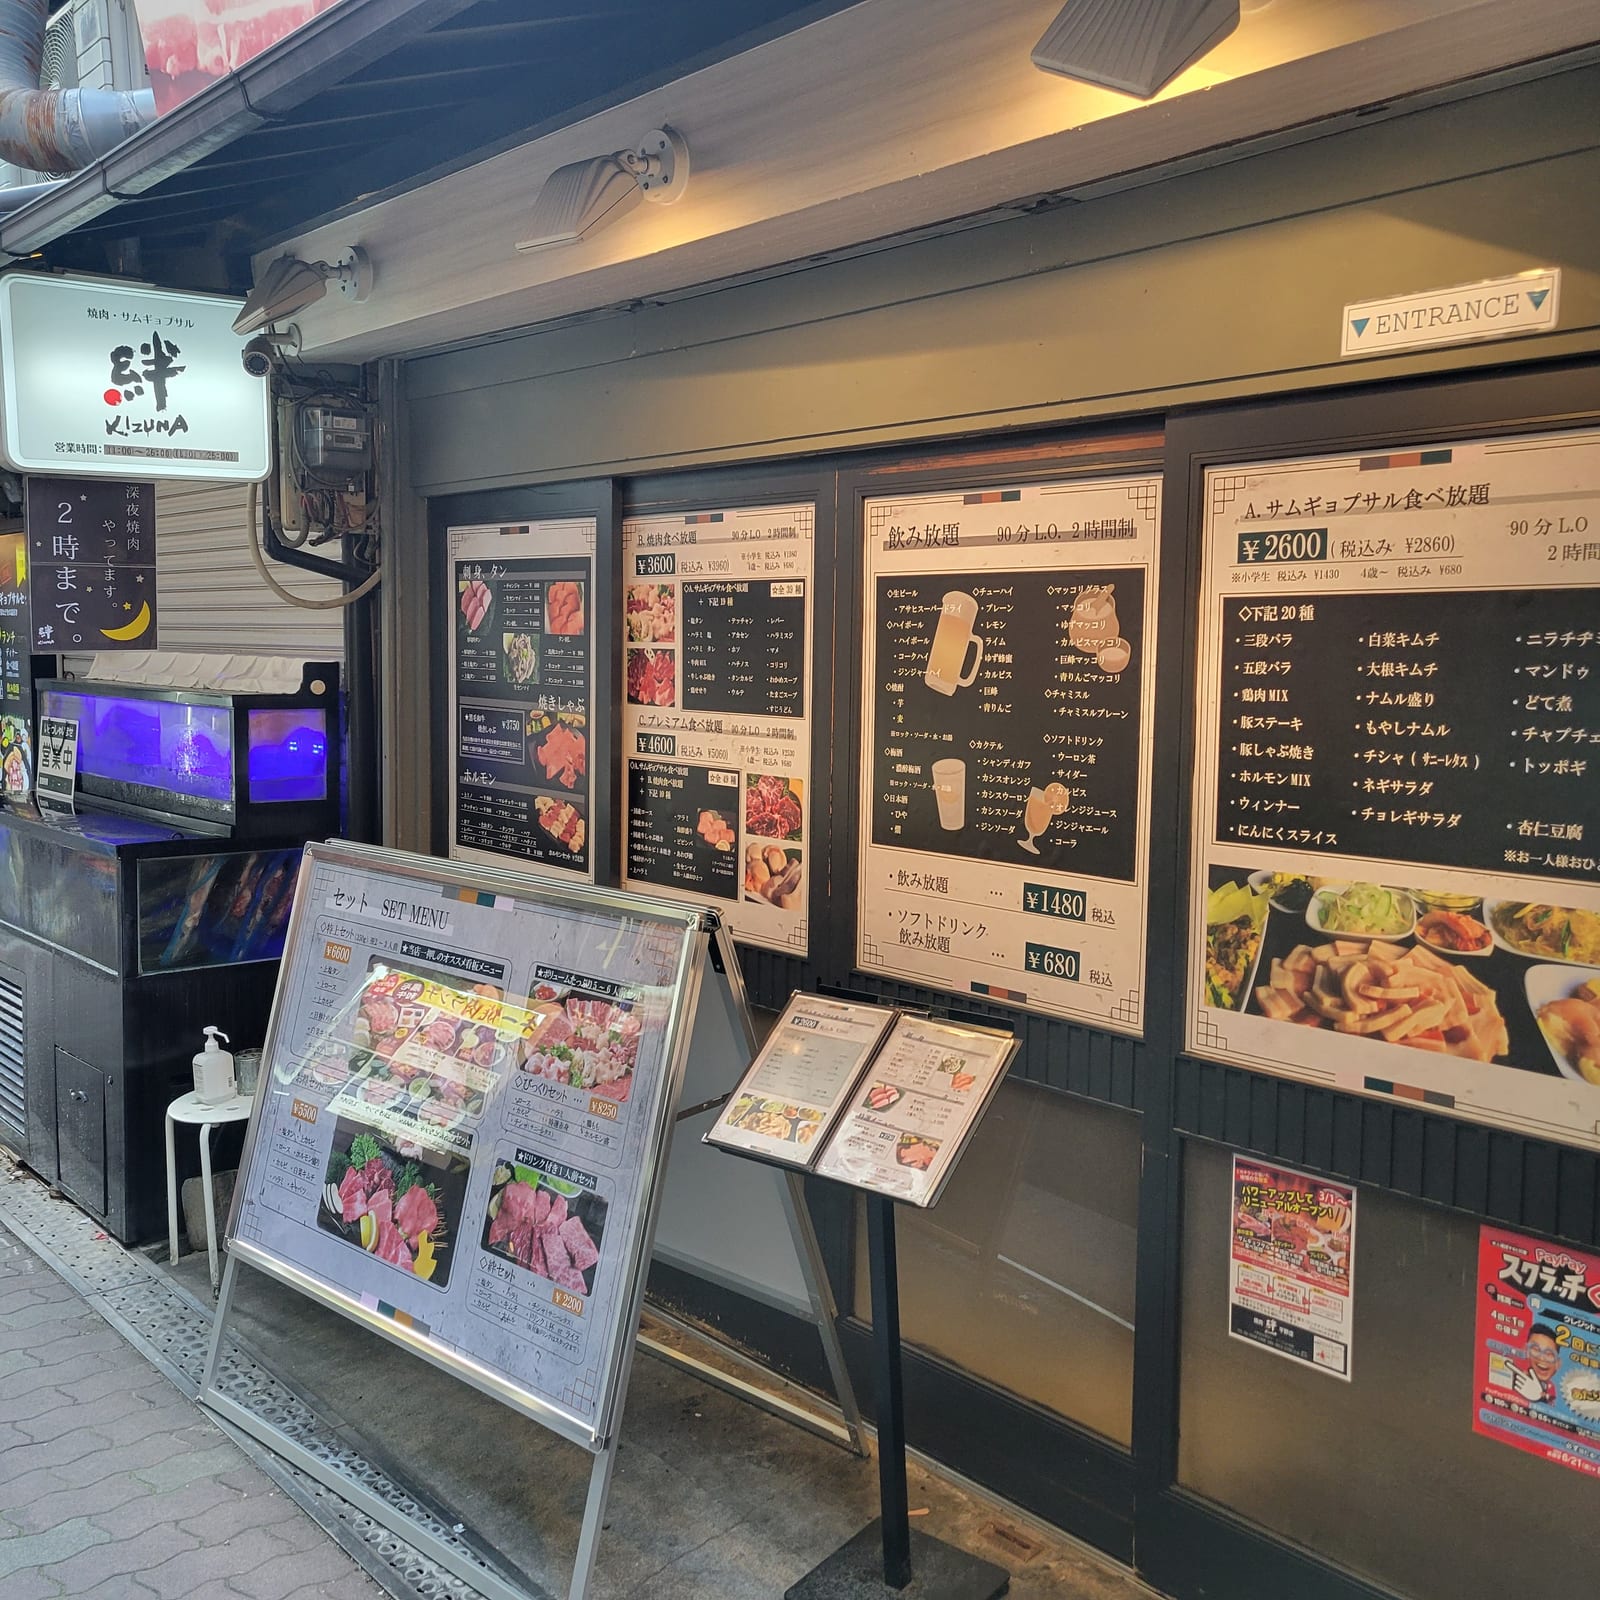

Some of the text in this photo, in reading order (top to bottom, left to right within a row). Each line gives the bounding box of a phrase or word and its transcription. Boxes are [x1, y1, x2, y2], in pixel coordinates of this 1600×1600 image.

[1376, 294, 1519, 334] ENTRANCE
[105, 415, 189, 437] KIZUNA
[1245, 483, 1491, 519] A.サムギョプサル食べ放題
[126, 485, 140, 551] 深夜焼肉
[888, 522, 960, 549] 飲み放題
[1243, 532, 1321, 561] ¥2600
[637, 555, 673, 574] ¥3600
[893, 589, 918, 598] 生ビール
[979, 587, 1014, 596] チューハイ
[1054, 585, 1108, 594] マッコリグラス
[1061, 603, 1091, 612] マッコリ
[986, 621, 1006, 629] レモン
[1061, 620, 1106, 630] ゆずマッコリ
[985, 637, 1006, 646] ライム
[1244, 633, 1293, 647] 三段バラ
[1368, 632, 1440, 647] 白菜キムチ
[1526, 631, 1600, 647] ニラチヂ
[1243, 661, 1292, 675] 五段バラ
[1366, 662, 1438, 677] 大根キムチ
[1525, 663, 1589, 680] マンドゥ
[1060, 672, 1120, 684] 青りんごマッコリ
[1051, 689, 1090, 699] チャミスル
[1366, 691, 1434, 707] ナムル盛り
[538, 694, 584, 712] 焼きしゃぶ
[983, 703, 1012, 713] 青りんご
[1525, 695, 1573, 712] どて煮
[1240, 715, 1303, 731] 豚ステーキ
[1366, 720, 1451, 736] もやしナムル
[638, 737, 673, 755] ¥4600
[976, 740, 1004, 750] カクテル
[1052, 735, 1104, 747] ソフトドリンク
[1058, 752, 1096, 765] ウーロン茶
[1240, 742, 1314, 760] 豚しゃぶ焼き
[1057, 769, 1088, 779] サイダー
[1525, 758, 1586, 776] トッポギ
[463, 769, 496, 785] ホルモン
[982, 773, 1031, 786] カシスオレンジ
[1362, 778, 1434, 796] ネギサラダ
[981, 806, 1023, 819] カシスソーダ
[1240, 796, 1300, 813] ウィンナー
[1361, 807, 1462, 828] チョレギサラダ
[981, 822, 1016, 834] ジンソーダ
[1238, 824, 1337, 845] にんにくスライス
[1517, 820, 1583, 840] 杏仁豆腐
[1055, 838, 1077, 848] コーラ
[1504, 850, 1600, 871] ※お一人様おひ
[897, 869, 1115, 925] 飲み放題 ¥1480 税込
[334, 888, 450, 930] セット SET MENU
[897, 909, 987, 939] ソフトドリンク
[899, 928, 1113, 987] 飲み放題 ¥680 税込
[590, 1100, 617, 1119] ¥8250
[1242, 1185, 1313, 1205] パワーアップして
[1535, 1248, 1586, 1274] PayPay
[1499, 1253, 1586, 1301] スクラッチ
[554, 1293, 582, 1312] ¥2200
